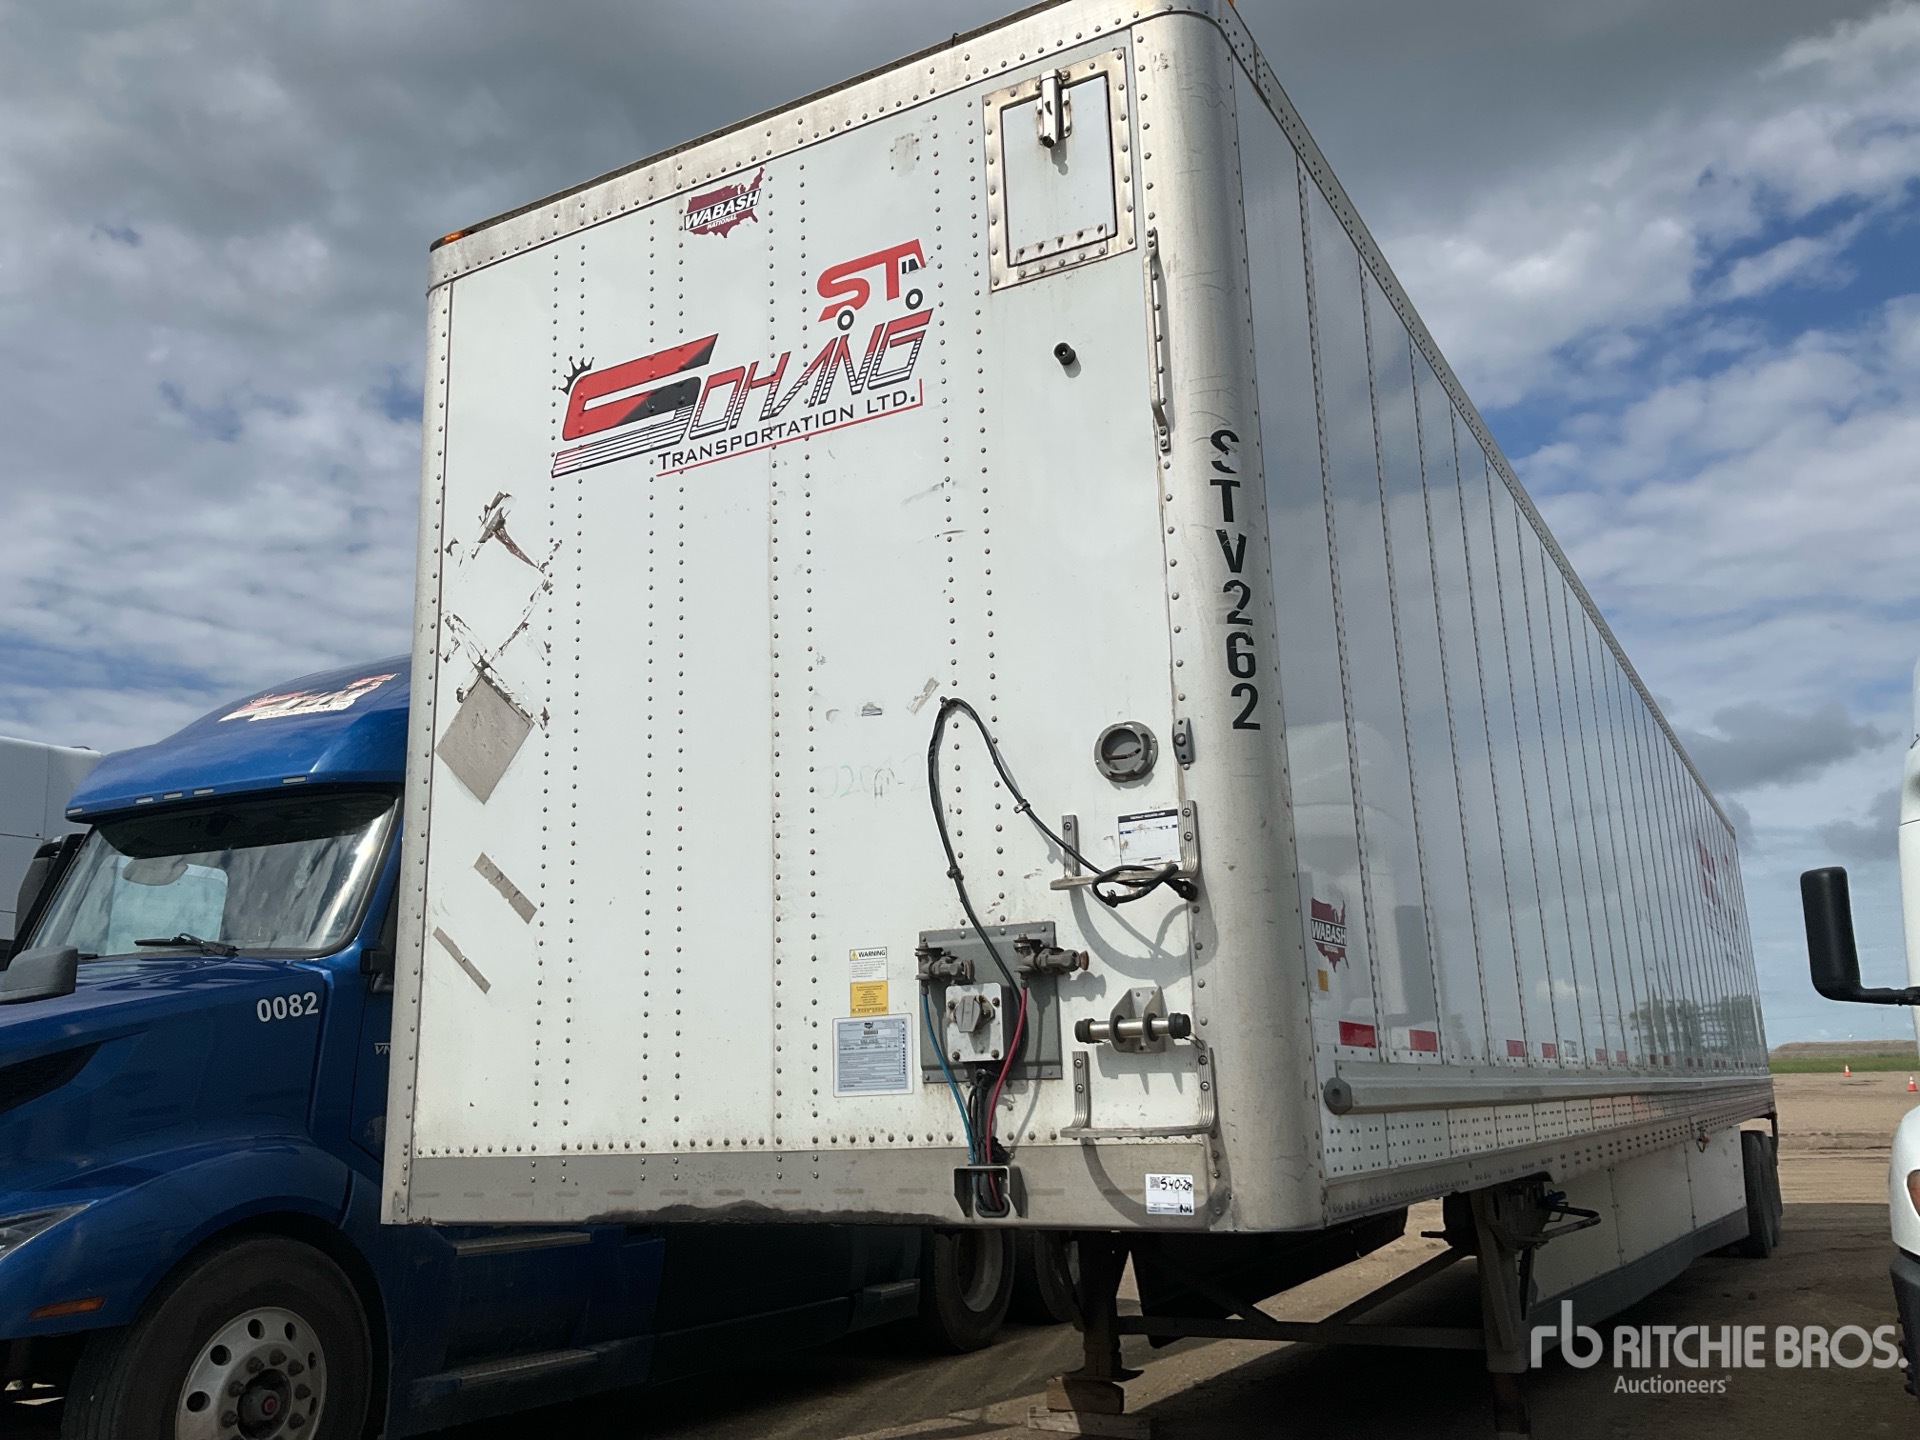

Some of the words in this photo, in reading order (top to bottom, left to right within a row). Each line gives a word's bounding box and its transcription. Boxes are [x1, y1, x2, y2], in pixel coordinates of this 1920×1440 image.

[685, 190, 760, 229] WABASH
[658, 408, 855, 471] TRANSPORTATION
[866, 390, 916, 416] LTD.
[1210, 429, 1261, 730] STV262
[1311, 920, 1346, 945] WABASH
[257, 991, 319, 1022] 0082
